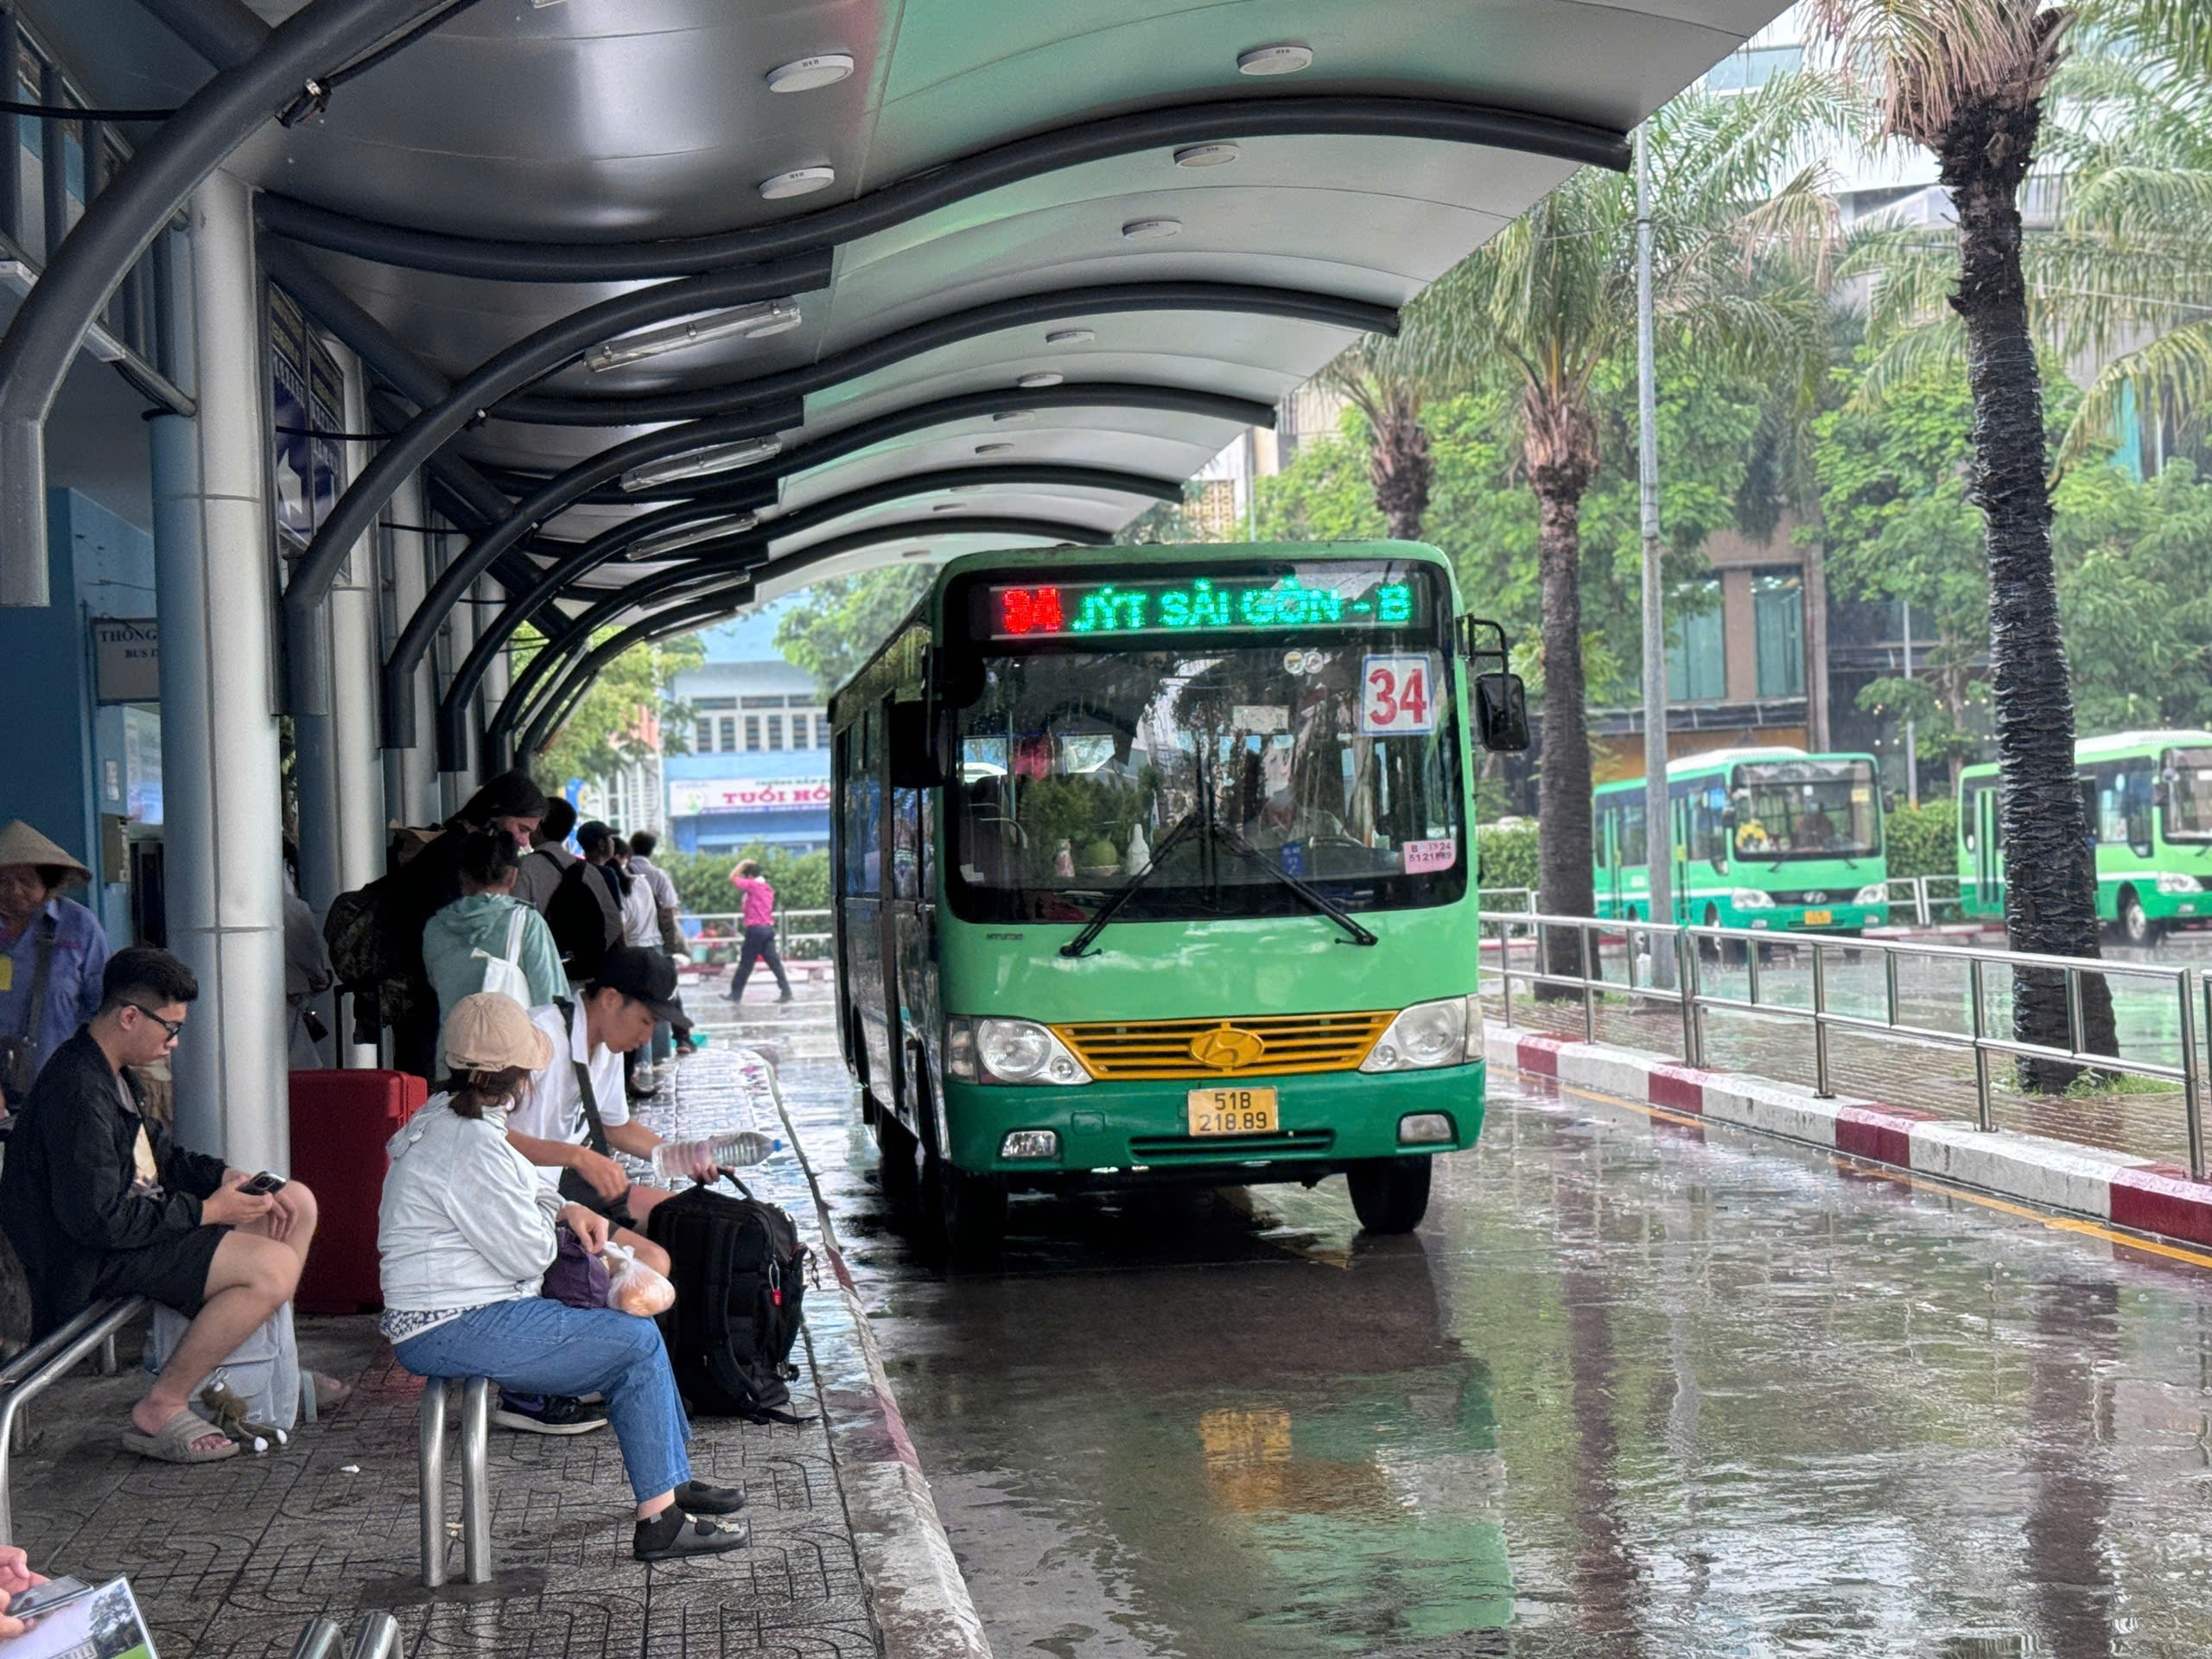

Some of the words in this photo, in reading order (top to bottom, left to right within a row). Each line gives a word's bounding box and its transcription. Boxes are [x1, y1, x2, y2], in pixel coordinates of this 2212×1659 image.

[1003, 587, 1061, 634] 34
[1368, 668, 1427, 726] 34
[1214, 1091, 1251, 1110] 51B
[1198, 1111, 1267, 1132] 218.89
